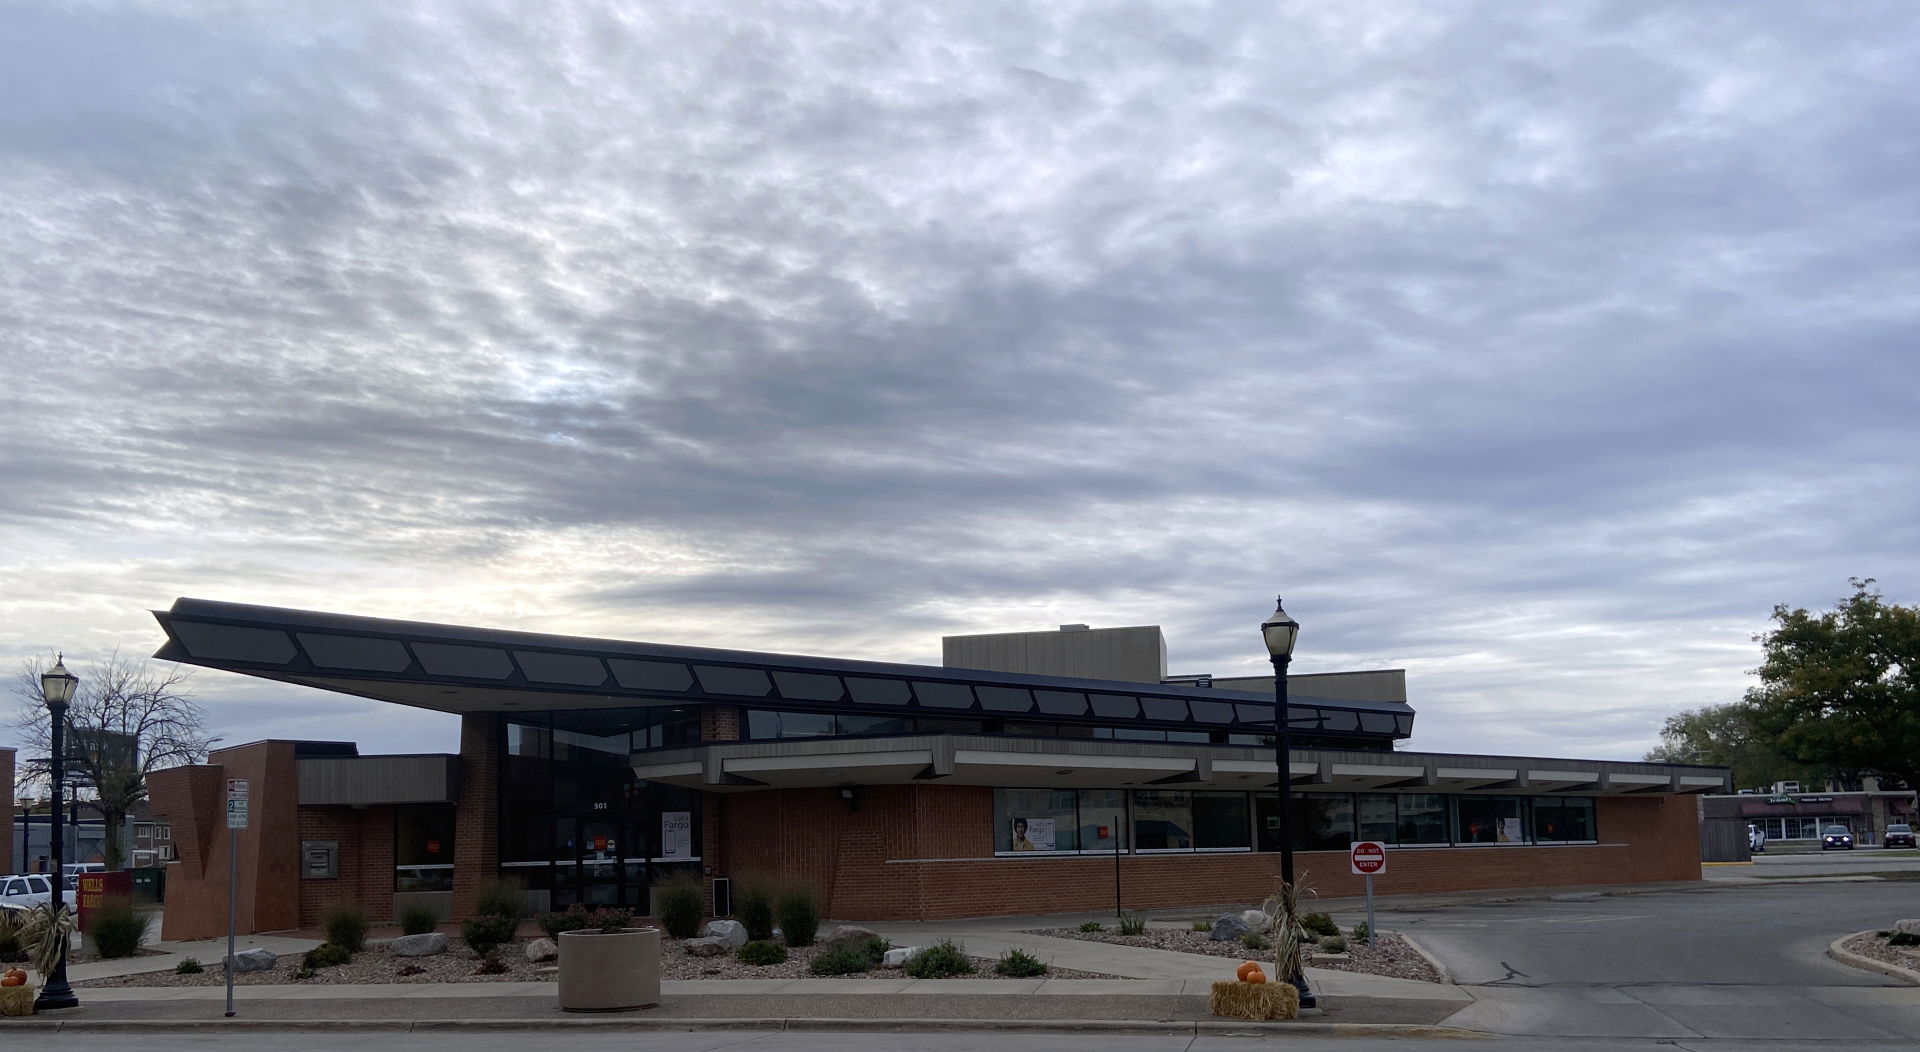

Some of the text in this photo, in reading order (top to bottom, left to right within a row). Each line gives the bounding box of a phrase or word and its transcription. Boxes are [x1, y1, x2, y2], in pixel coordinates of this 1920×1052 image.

[229, 801, 234, 811] 2
[593, 802, 607, 810] 501
[664, 820, 689, 831] Fargo
[82, 878, 104, 892] WELLS
[82, 894, 104, 908] FARGO
